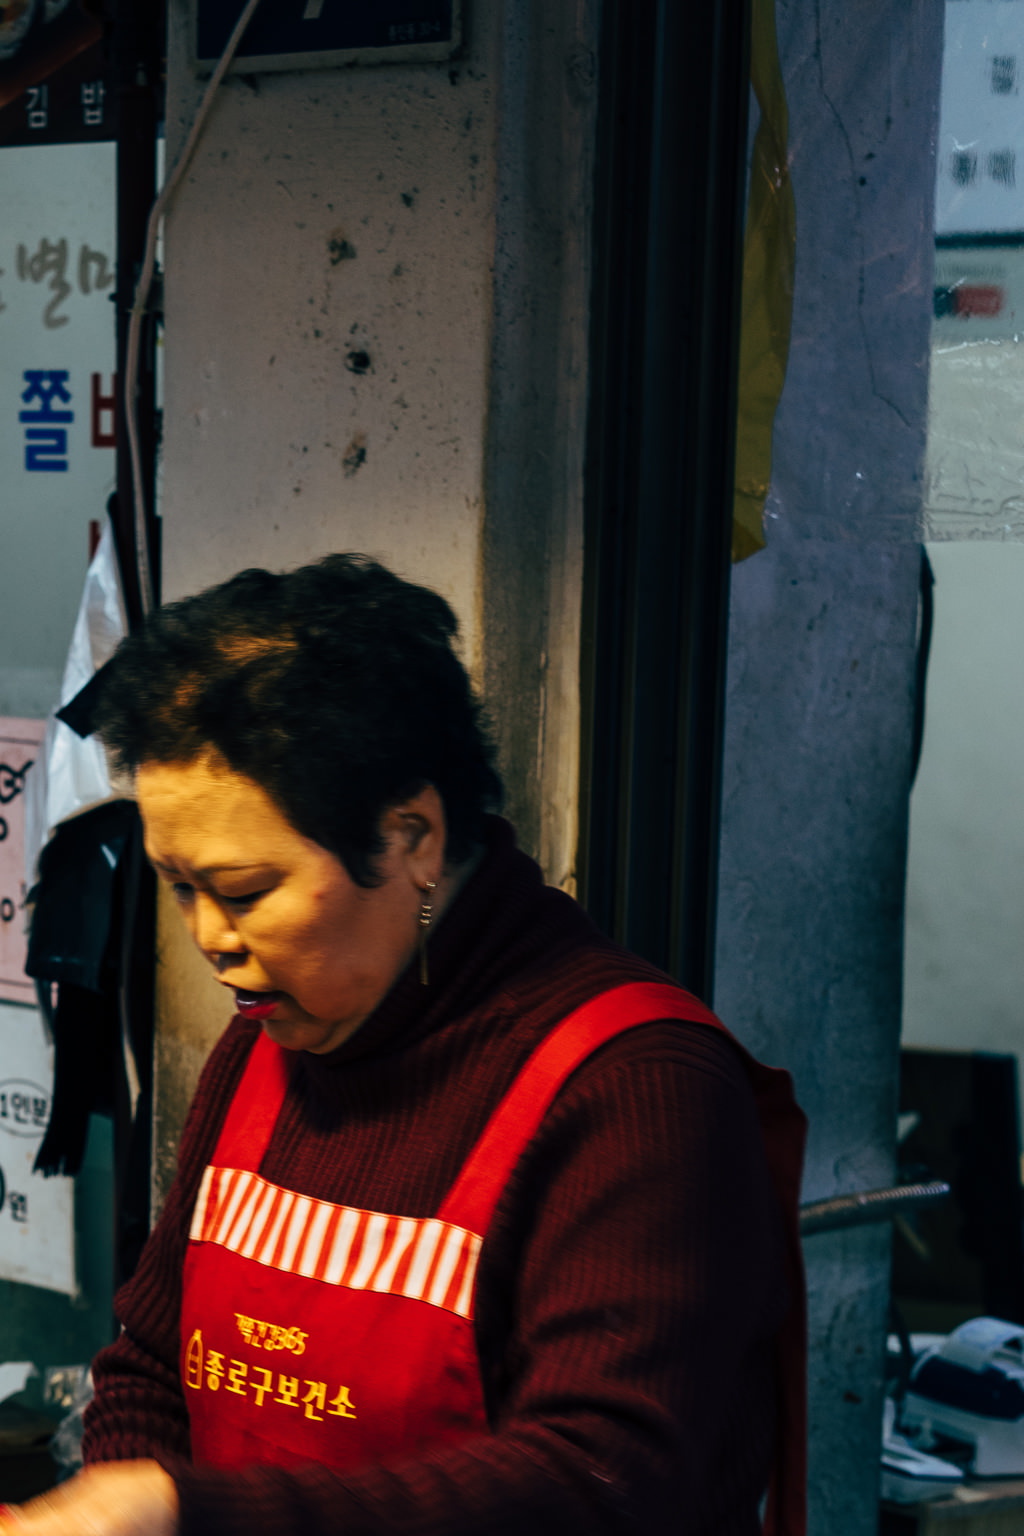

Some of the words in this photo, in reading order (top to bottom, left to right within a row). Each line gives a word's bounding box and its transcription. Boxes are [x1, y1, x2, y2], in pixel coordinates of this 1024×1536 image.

[27, 82, 104, 128] 김밥
[0, 1092, 47, 1128] 1인분
[204, 1349, 357, 1422] 종로구보건소
